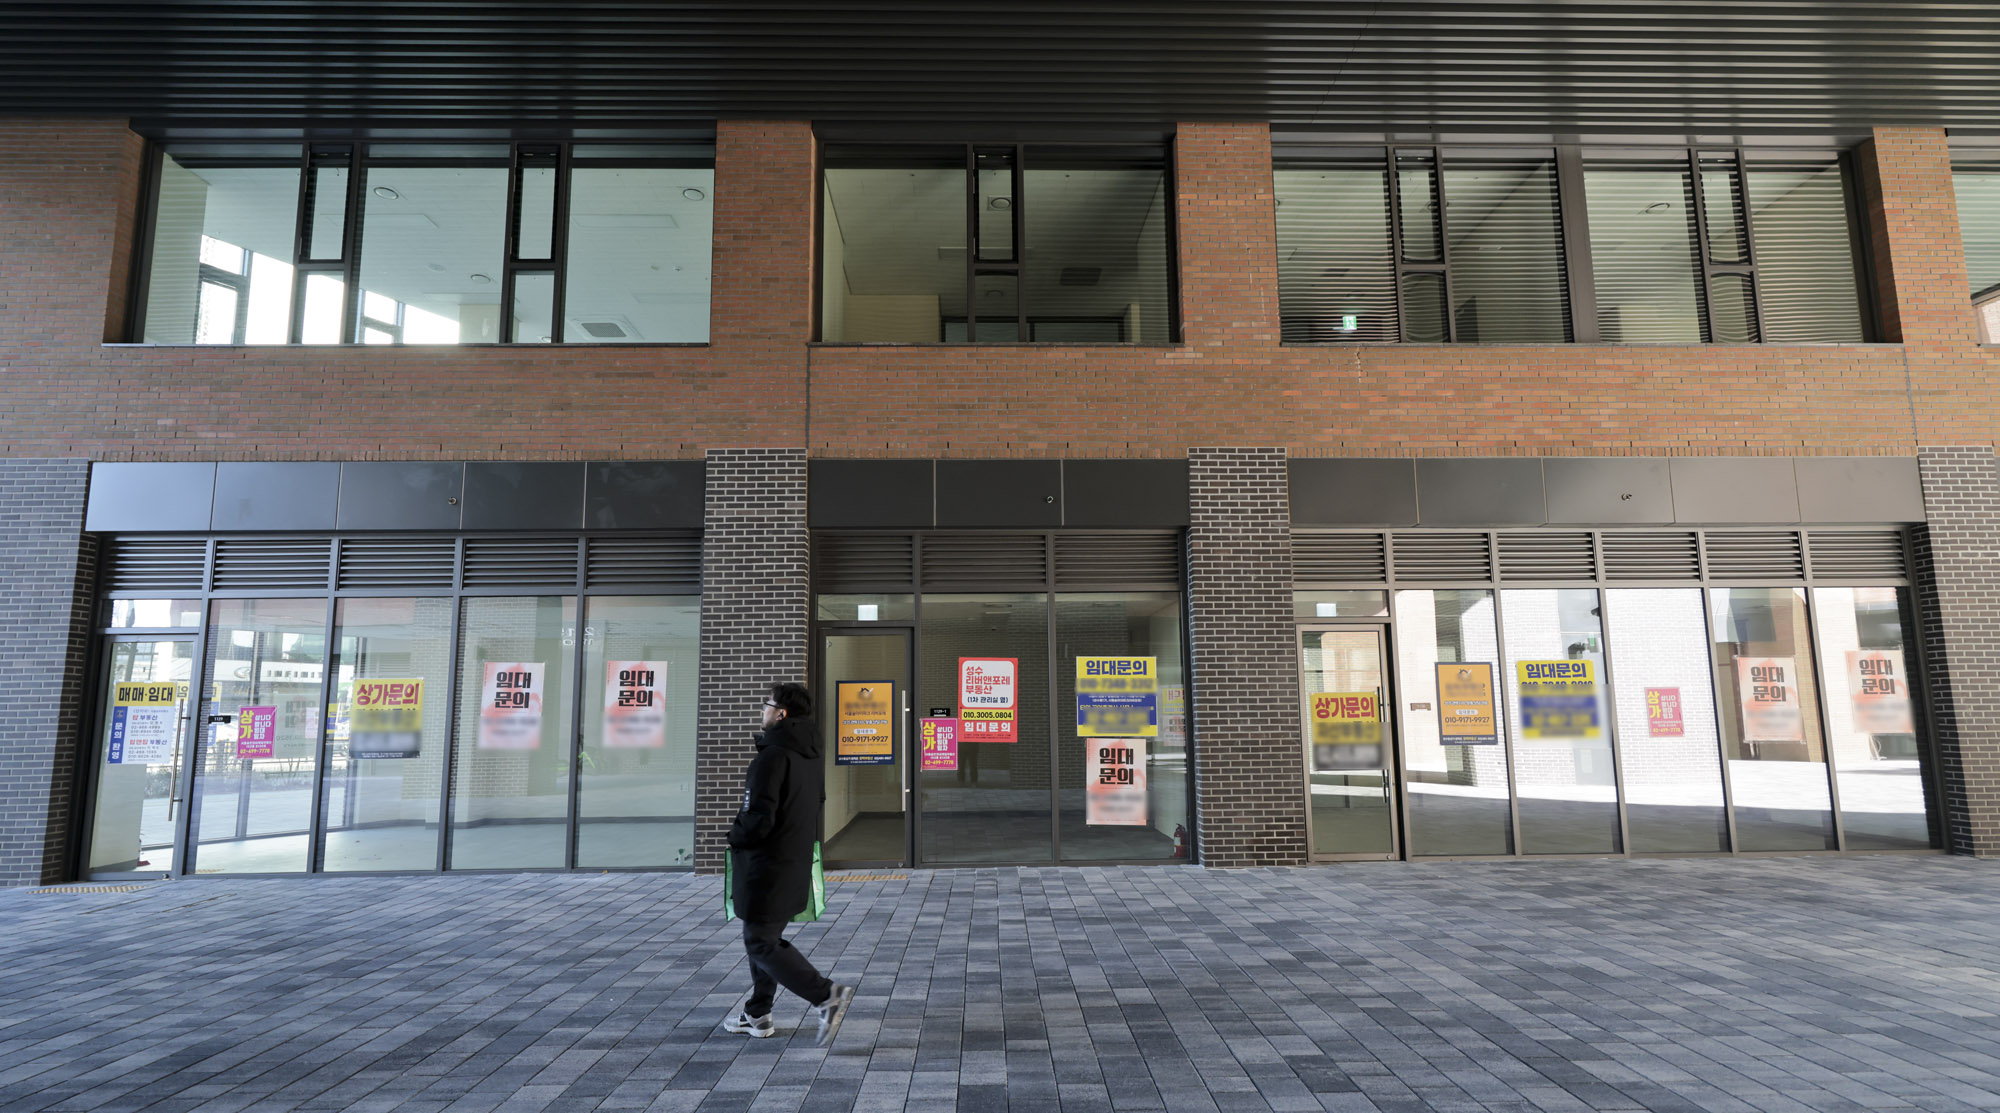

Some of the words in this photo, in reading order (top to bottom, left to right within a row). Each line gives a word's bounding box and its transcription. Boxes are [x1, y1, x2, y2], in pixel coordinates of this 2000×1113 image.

[966, 666, 984, 676] 성수
[1086, 660, 1147, 676] 임대문의
[1526, 663, 1587, 678] 임대문의
[1750, 666, 1785, 683] 임대
[1859, 659, 1893, 675] 임대
[496, 672, 532, 689] 임대
[619, 670, 655, 687] 임대
[966, 676, 1011, 685] 리버앤포레
[1862, 678, 1896, 695] 문의
[118, 687, 174, 702] 매매·임대
[357, 683, 420, 706] 상가문의
[966, 685, 992, 694] 부동산
[1753, 686, 1787, 702] 문의
[494, 692, 530, 709] 문의
[618, 690, 654, 707] 문의
[1648, 691, 1662, 718] 상가
[1315, 696, 1375, 719] 상가문의
[240, 710, 255, 739] 상가
[964, 722, 1011, 732] 임대문의
[1444, 716, 1490, 724] 010-9171-9927
[924, 722, 936, 750] 상가
[1099, 748, 1134, 765] 임대
[1099, 768, 1134, 785] 문의
